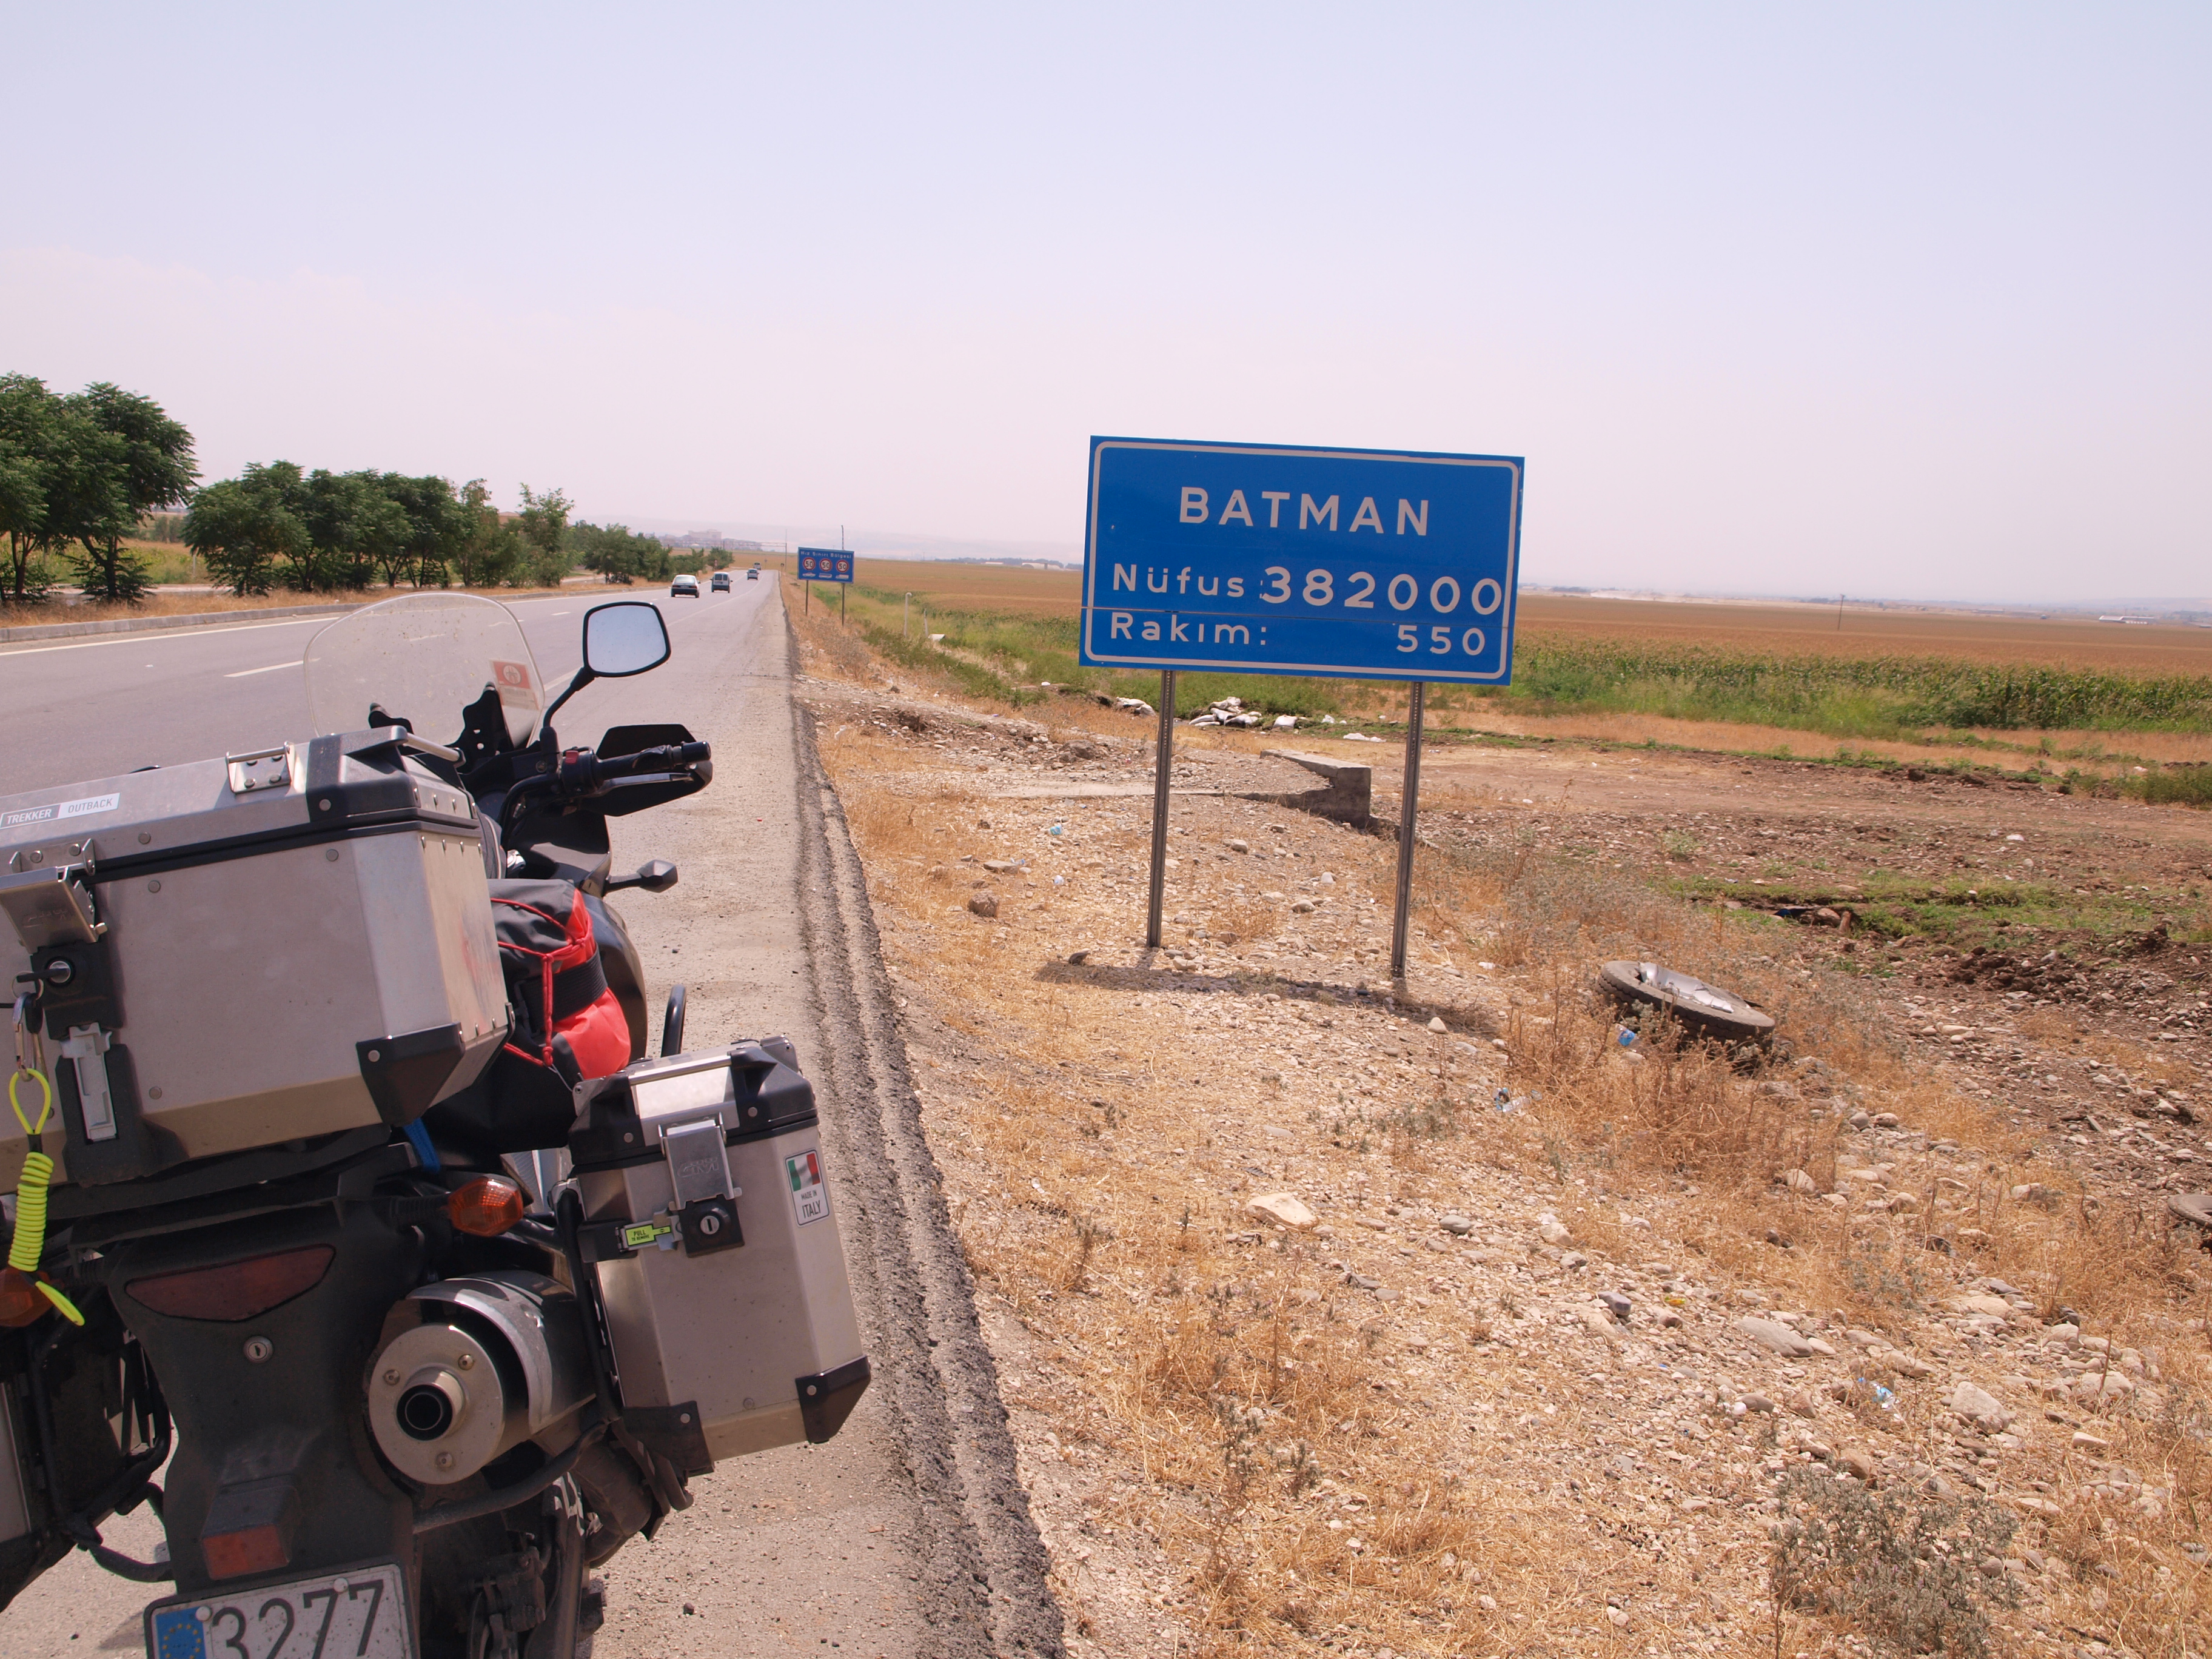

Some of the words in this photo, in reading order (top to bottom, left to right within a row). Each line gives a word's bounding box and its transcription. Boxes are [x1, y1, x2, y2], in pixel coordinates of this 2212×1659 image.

[1179, 486, 1429, 536] BATMAN
[1110, 611, 1267, 646] Rakım:
[1396, 625, 1486, 656] 550
[7, 808, 52, 825] TREKKER
[68, 797, 113, 813] OUTBACK
[802, 1200, 820, 1219] ITALY
[212, 1580, 384, 1659] 3277
